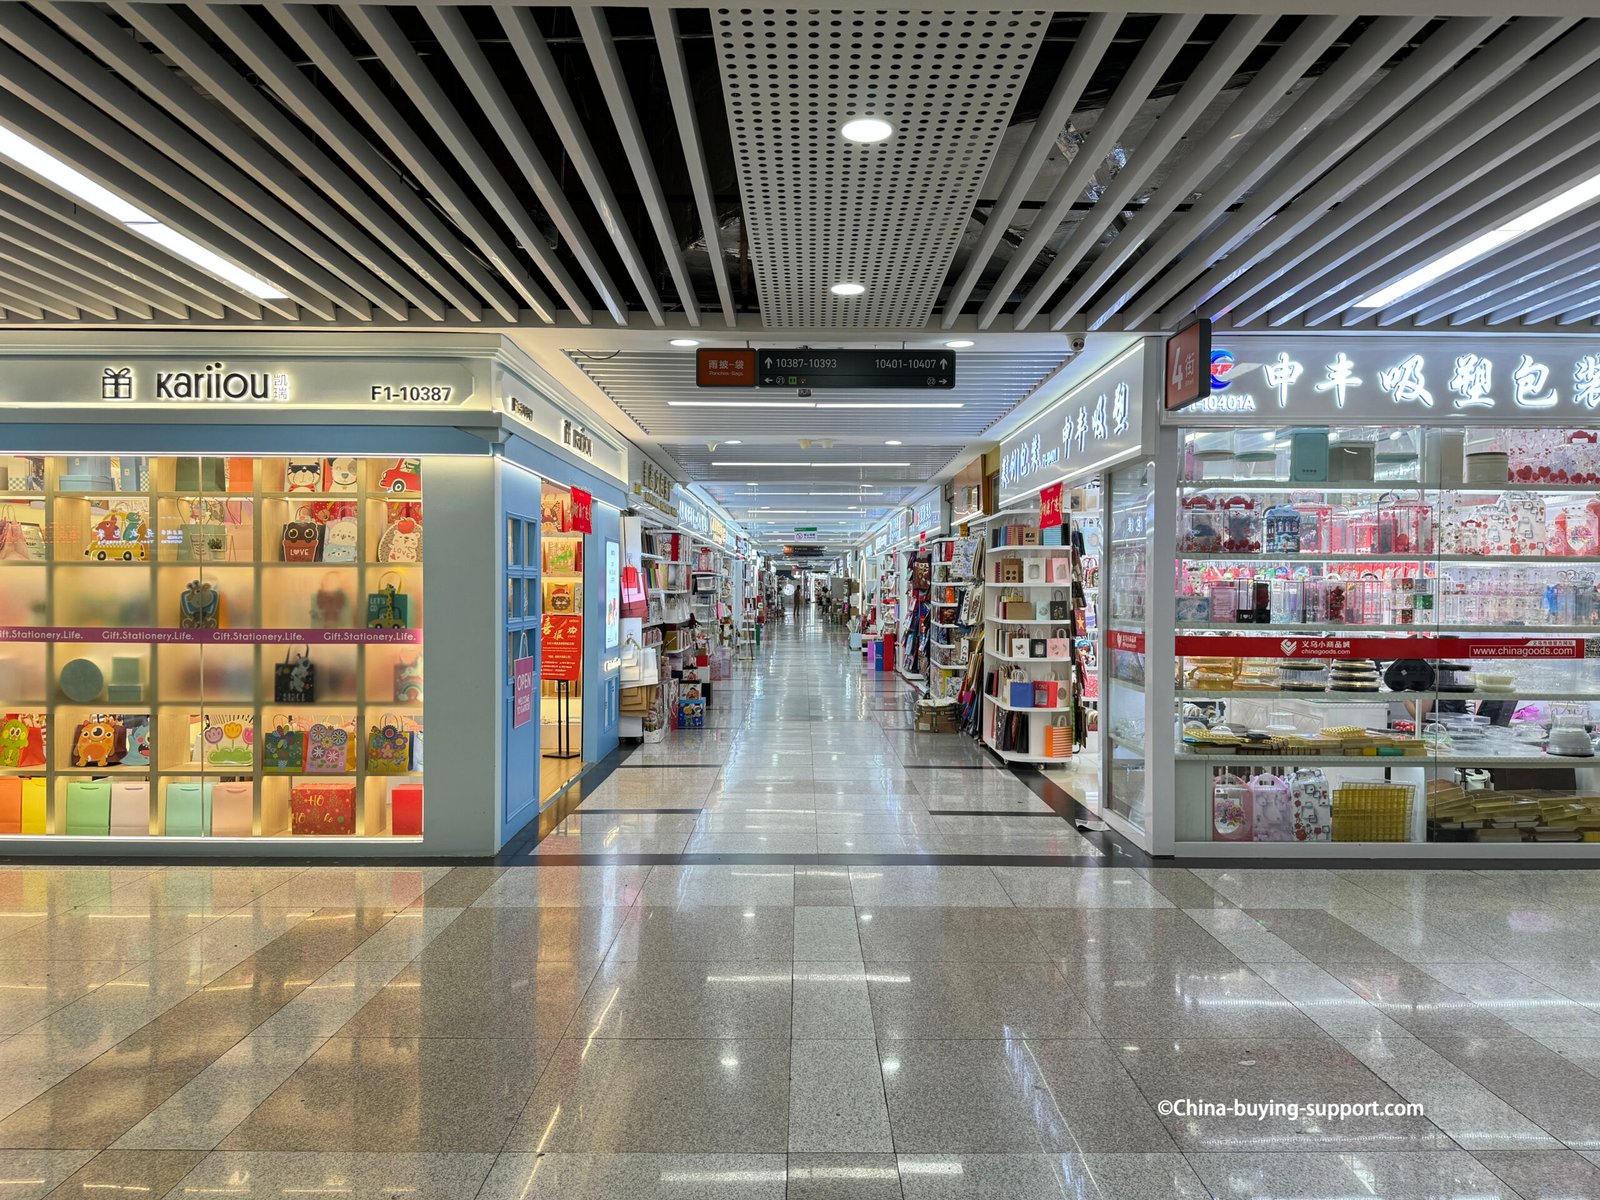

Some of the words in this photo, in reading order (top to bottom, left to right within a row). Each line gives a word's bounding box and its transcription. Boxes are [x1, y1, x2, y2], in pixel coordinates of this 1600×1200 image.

[775, 358, 837, 368] 10387-10393
[875, 359, 936, 369] 10401-10407
[371, 386, 452, 401] F1-10387
[1180, 396, 1256, 412] -10401A
[0, 629, 83, 641] ift.Stationery.Life.
[102, 631, 194, 642] Gift.Stationery.Life.
[213, 631, 305, 642] Gift.Stationery.Life.
[323, 631, 416, 642] Gift.Stationery.Life.
[1473, 646, 1573, 657] www.chinagoods.com
[517, 672, 531, 691] OPEN
